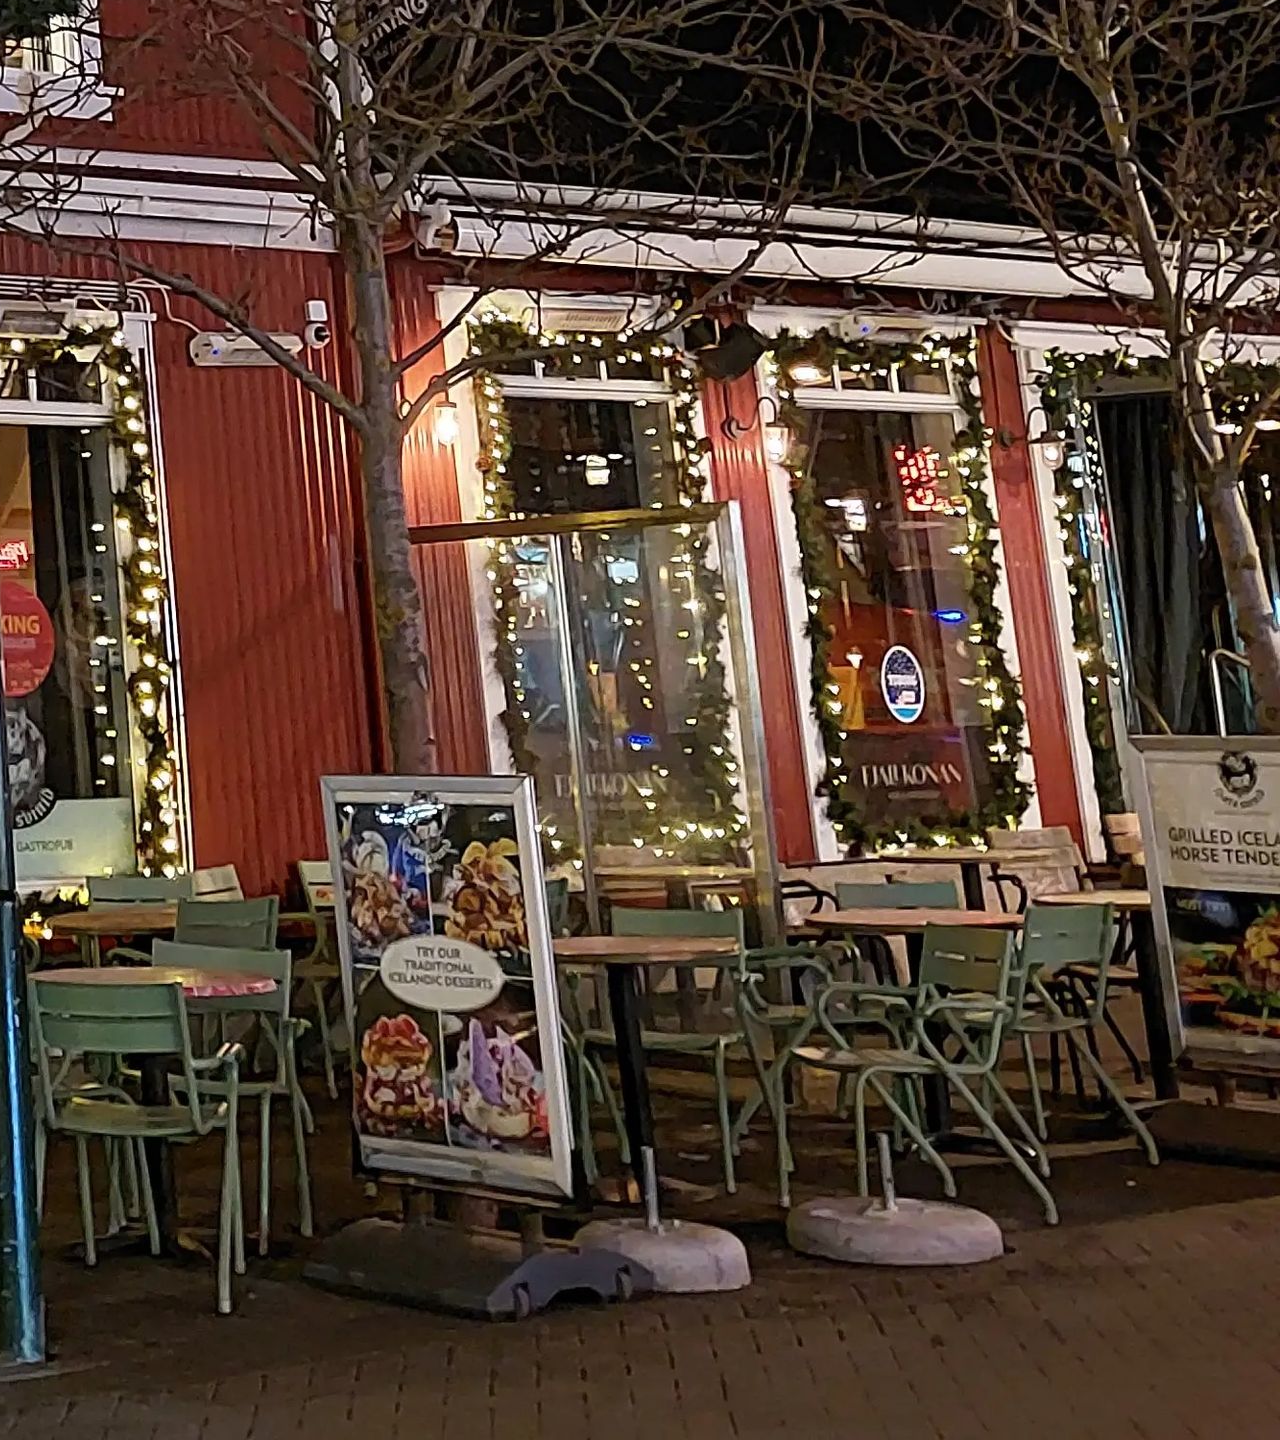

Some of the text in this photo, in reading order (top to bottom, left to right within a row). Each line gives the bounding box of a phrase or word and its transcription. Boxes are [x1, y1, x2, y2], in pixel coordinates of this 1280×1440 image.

[1169, 826, 1233, 845] GRILLED
[1171, 845, 1220, 863] HORSE
[416, 945, 461, 959] TRY OUR
[403, 959, 474, 975] TRADITIONAL
